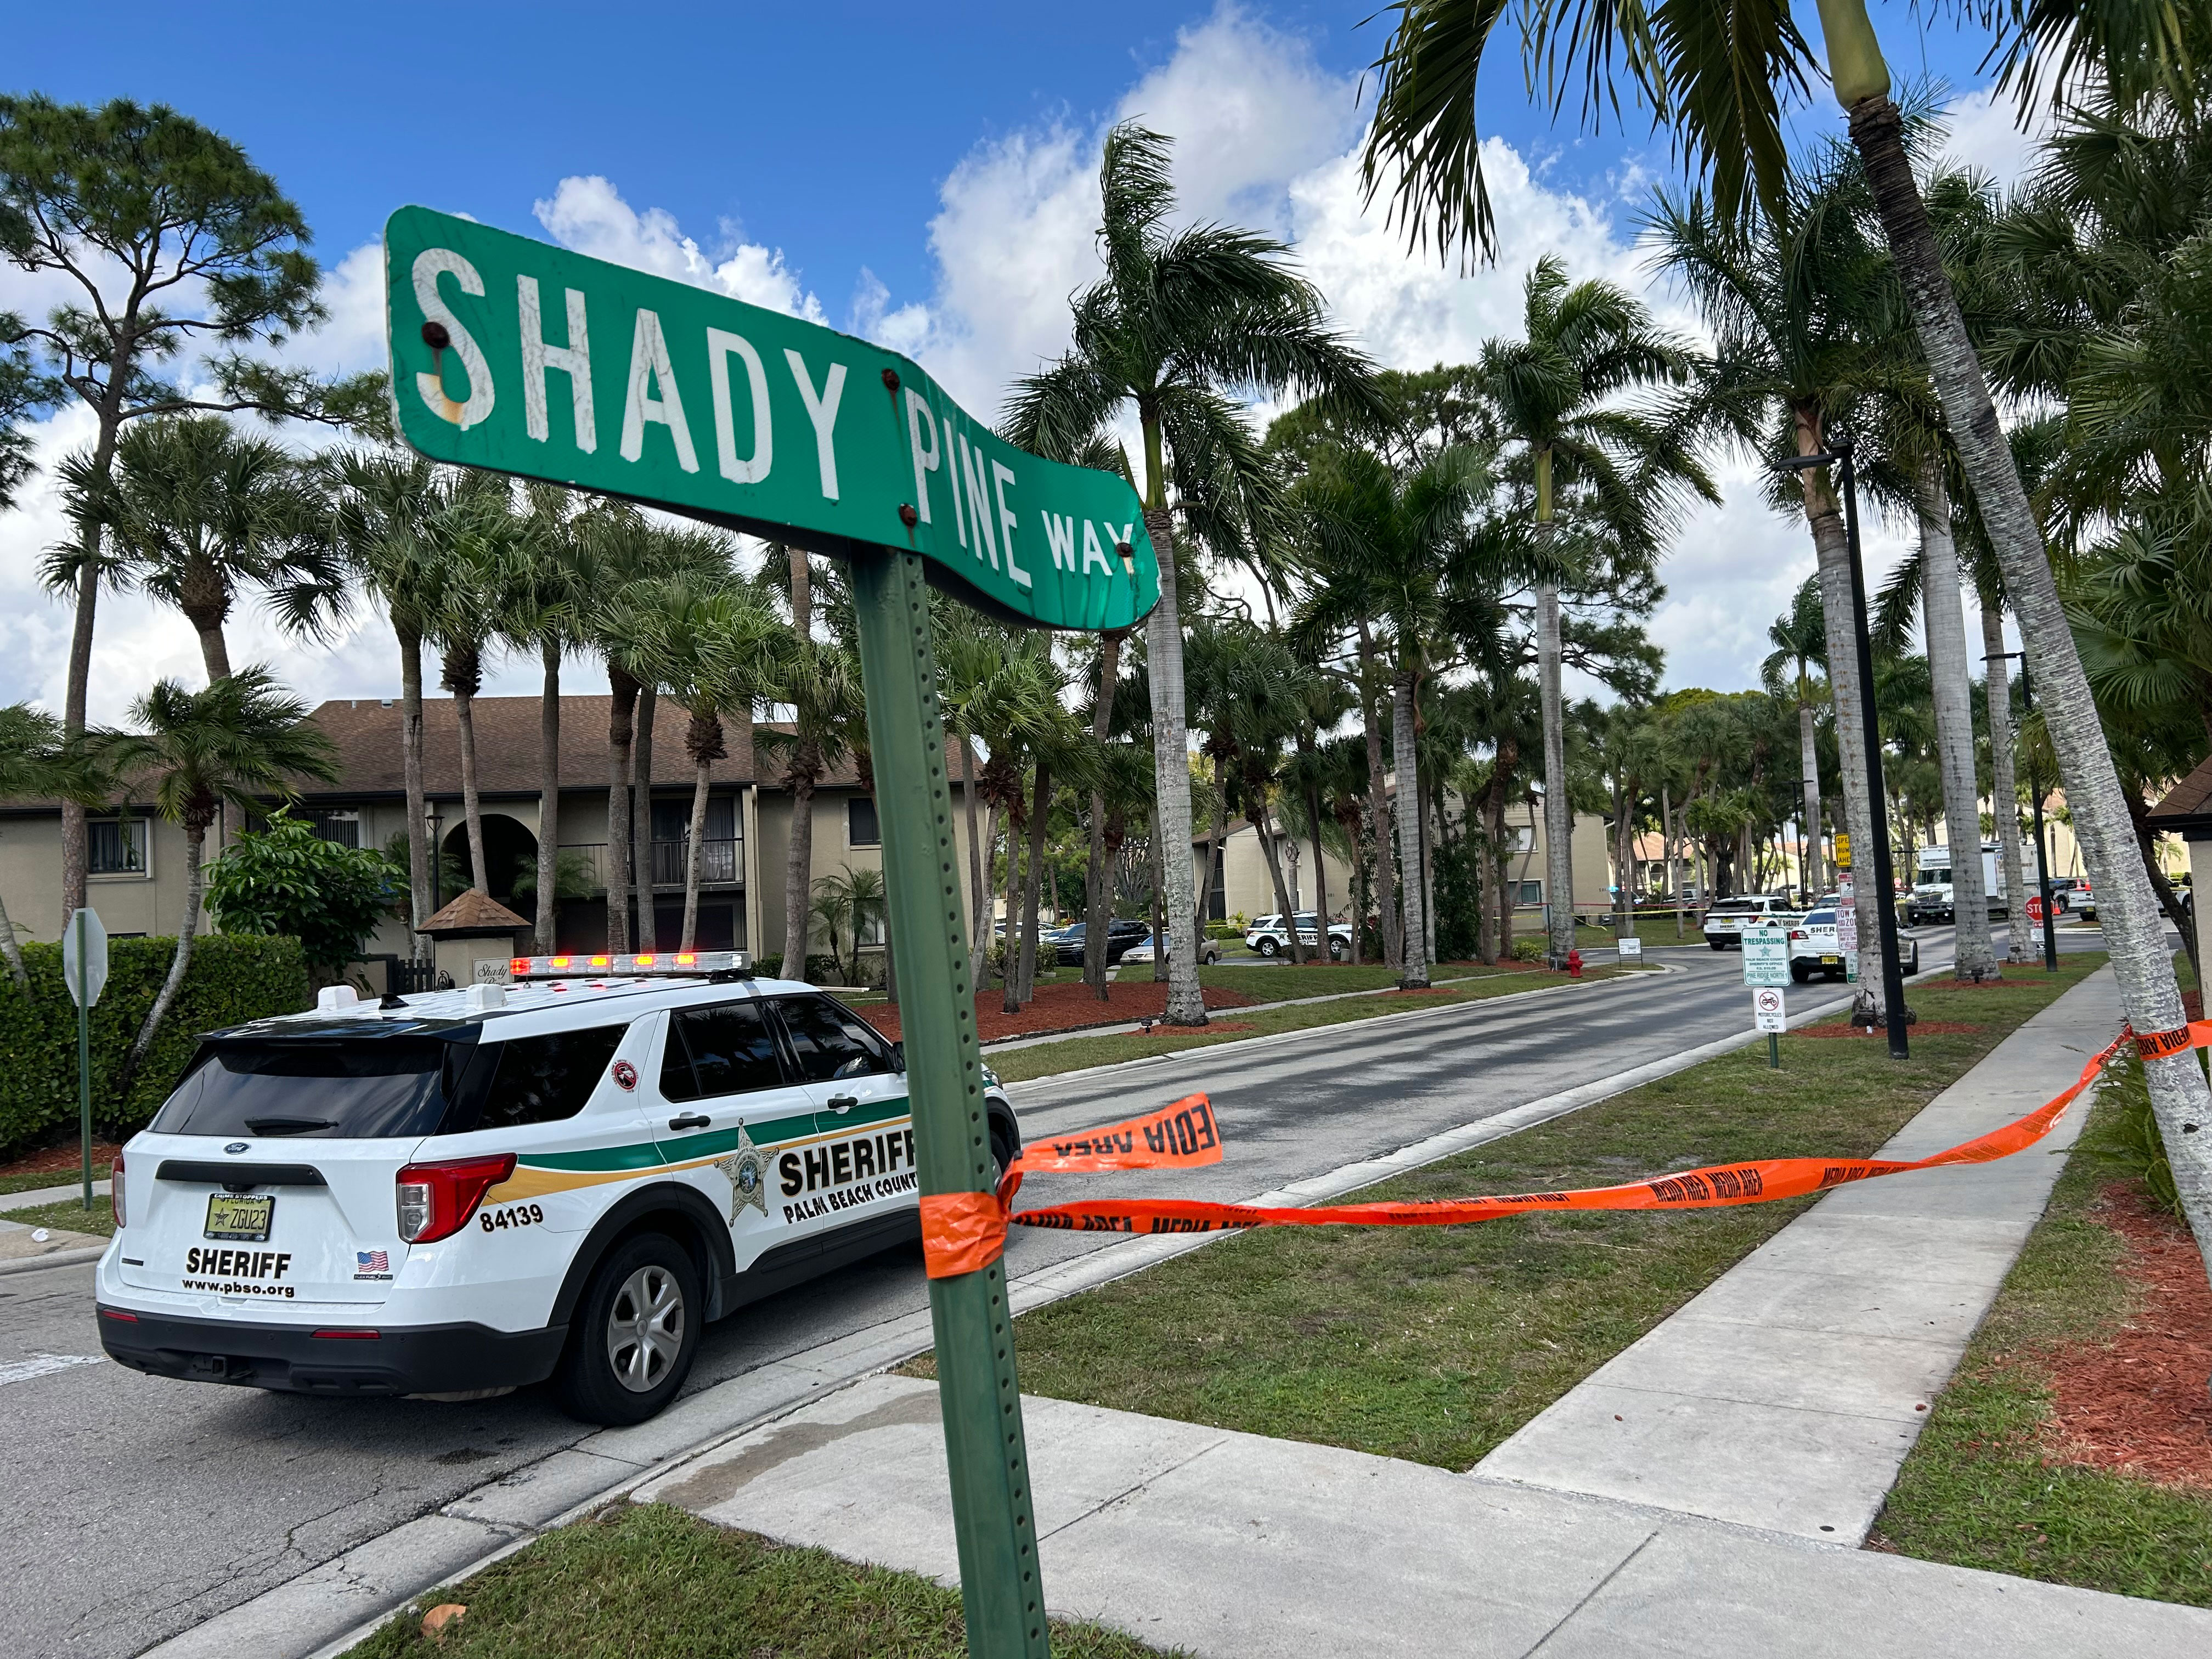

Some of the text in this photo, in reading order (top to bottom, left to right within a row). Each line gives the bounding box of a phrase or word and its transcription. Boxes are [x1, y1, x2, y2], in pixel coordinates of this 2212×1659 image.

[412, 247, 1135, 589] SHADY PINE WAY
[1837, 910, 1849, 918] TOW
[478, 964, 507, 979] Shady
[1052, 1103, 1216, 1156] EDIA AREA
[228, 1143, 245, 1153] Ford
[783, 1172, 918, 1224] PALM BEACH COUNT
[1647, 1168, 1763, 1202] MEDIA AREA MEDIA AREA
[230, 1208, 267, 1230] ZGU23
[479, 1204, 544, 1233] 84139
[187, 1248, 292, 1279] SHERIFF
[182, 1279, 295, 1298] www.pbso.org
